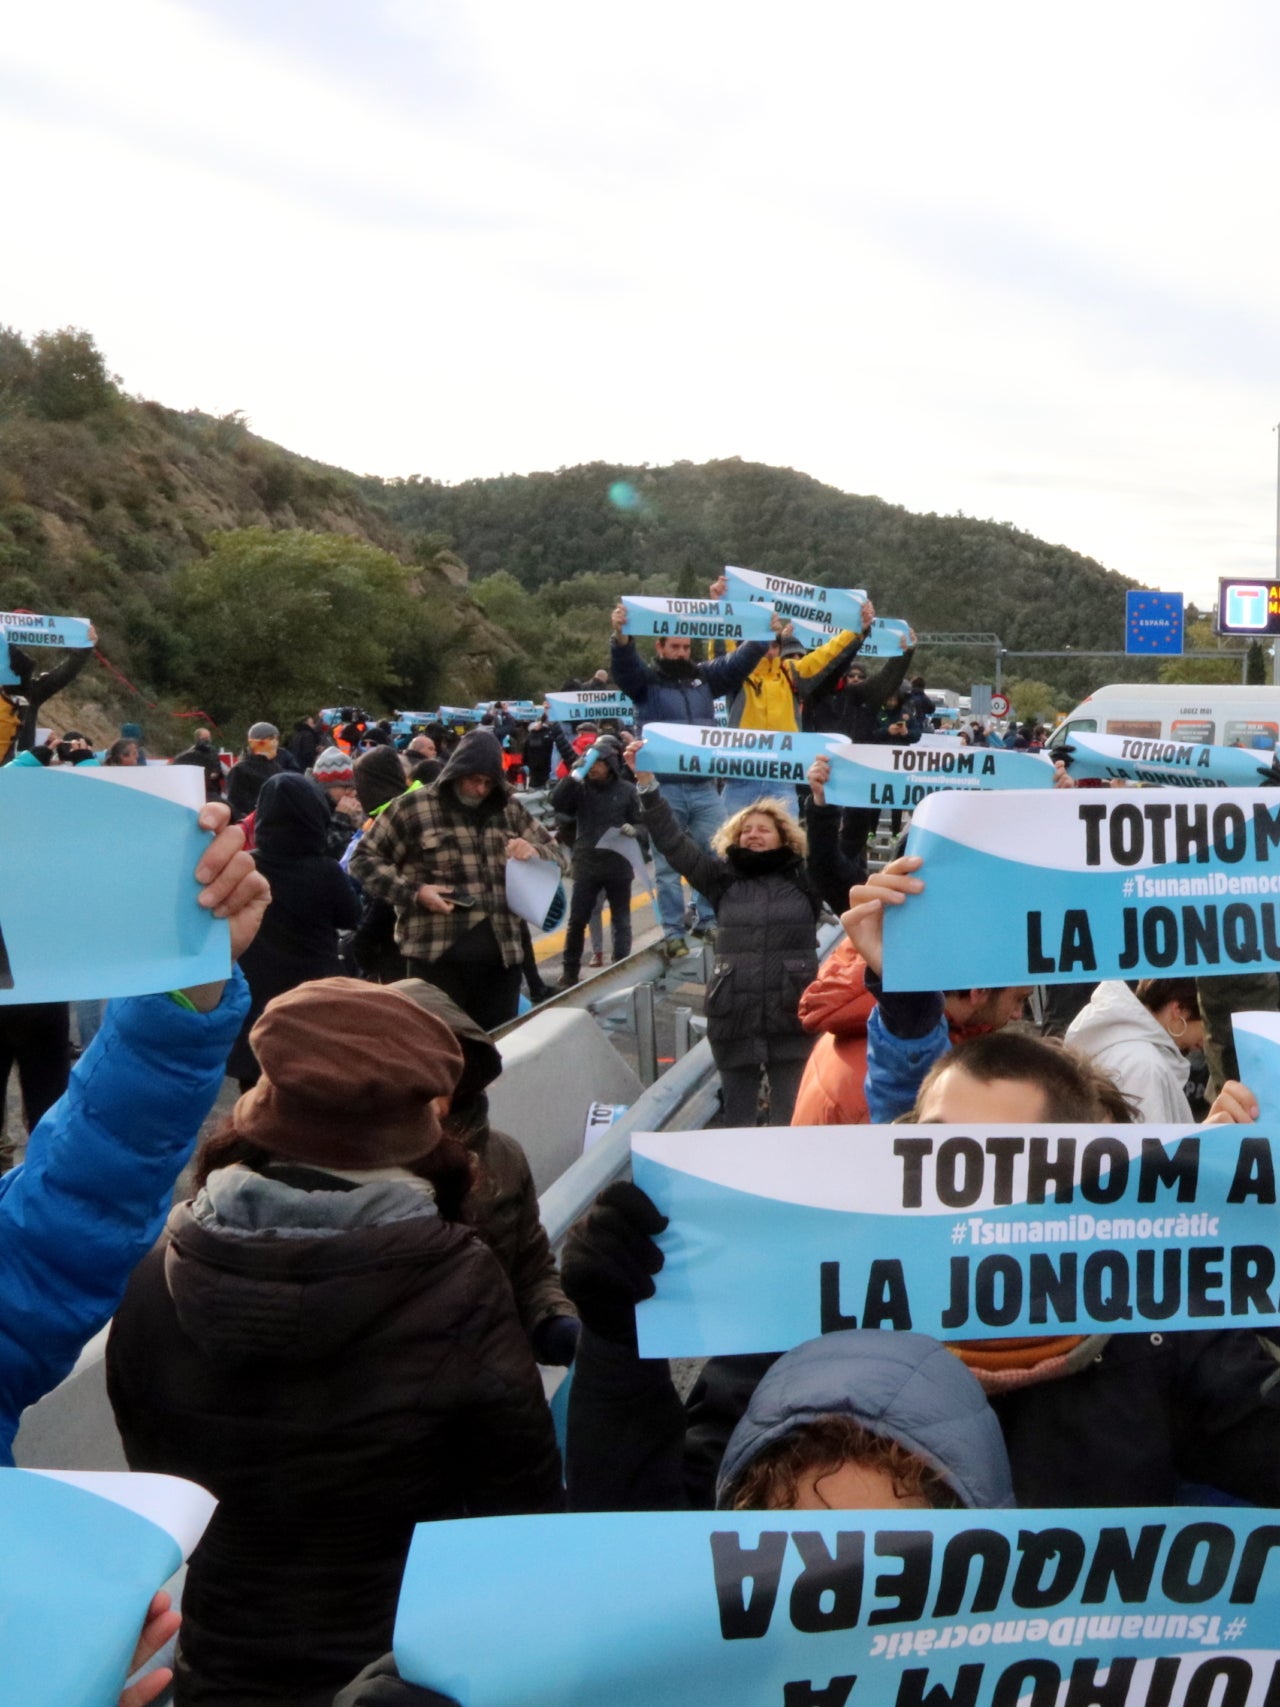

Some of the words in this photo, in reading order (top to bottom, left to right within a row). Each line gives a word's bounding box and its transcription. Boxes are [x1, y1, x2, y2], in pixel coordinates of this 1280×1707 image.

[765, 577, 815, 599] TOTHOM
[818, 590, 827, 602] A
[666, 600, 720, 615] TOTHOM
[725, 602, 734, 616] A
[772, 599, 832, 624] ONQUERA
[48, 618, 56, 628] A
[653, 621, 669, 635] LA
[674, 621, 743, 638] JONQUERA
[1139, 618, 1170, 627] ESPAÑA
[577, 692, 616, 703] TOTHOM
[569, 708, 580, 719] LA
[585, 707, 633, 717] JONQUERA
[700, 729, 774, 750] TOTHOM
[780, 735, 793, 751] A
[892, 750, 974, 774] TOTHOM
[981, 754, 995, 775] A
[1121, 740, 1194, 765] TOTHOM
[1197, 748, 1210, 768] A
[679, 755, 701, 772] LA
[708, 757, 804, 780] JONQUERA
[870, 784, 895, 804] LA
[1026, 908, 1097, 974] LA
[892, 1136, 1201, 1208] TOTHOM
[1225, 1137, 1277, 1204] A
[951, 1212, 1219, 1246] #TsunamiDemocràtic
[820, 1258, 913, 1335] LA
[868, 1613, 1247, 1660] #TsunamiDemocràtic
